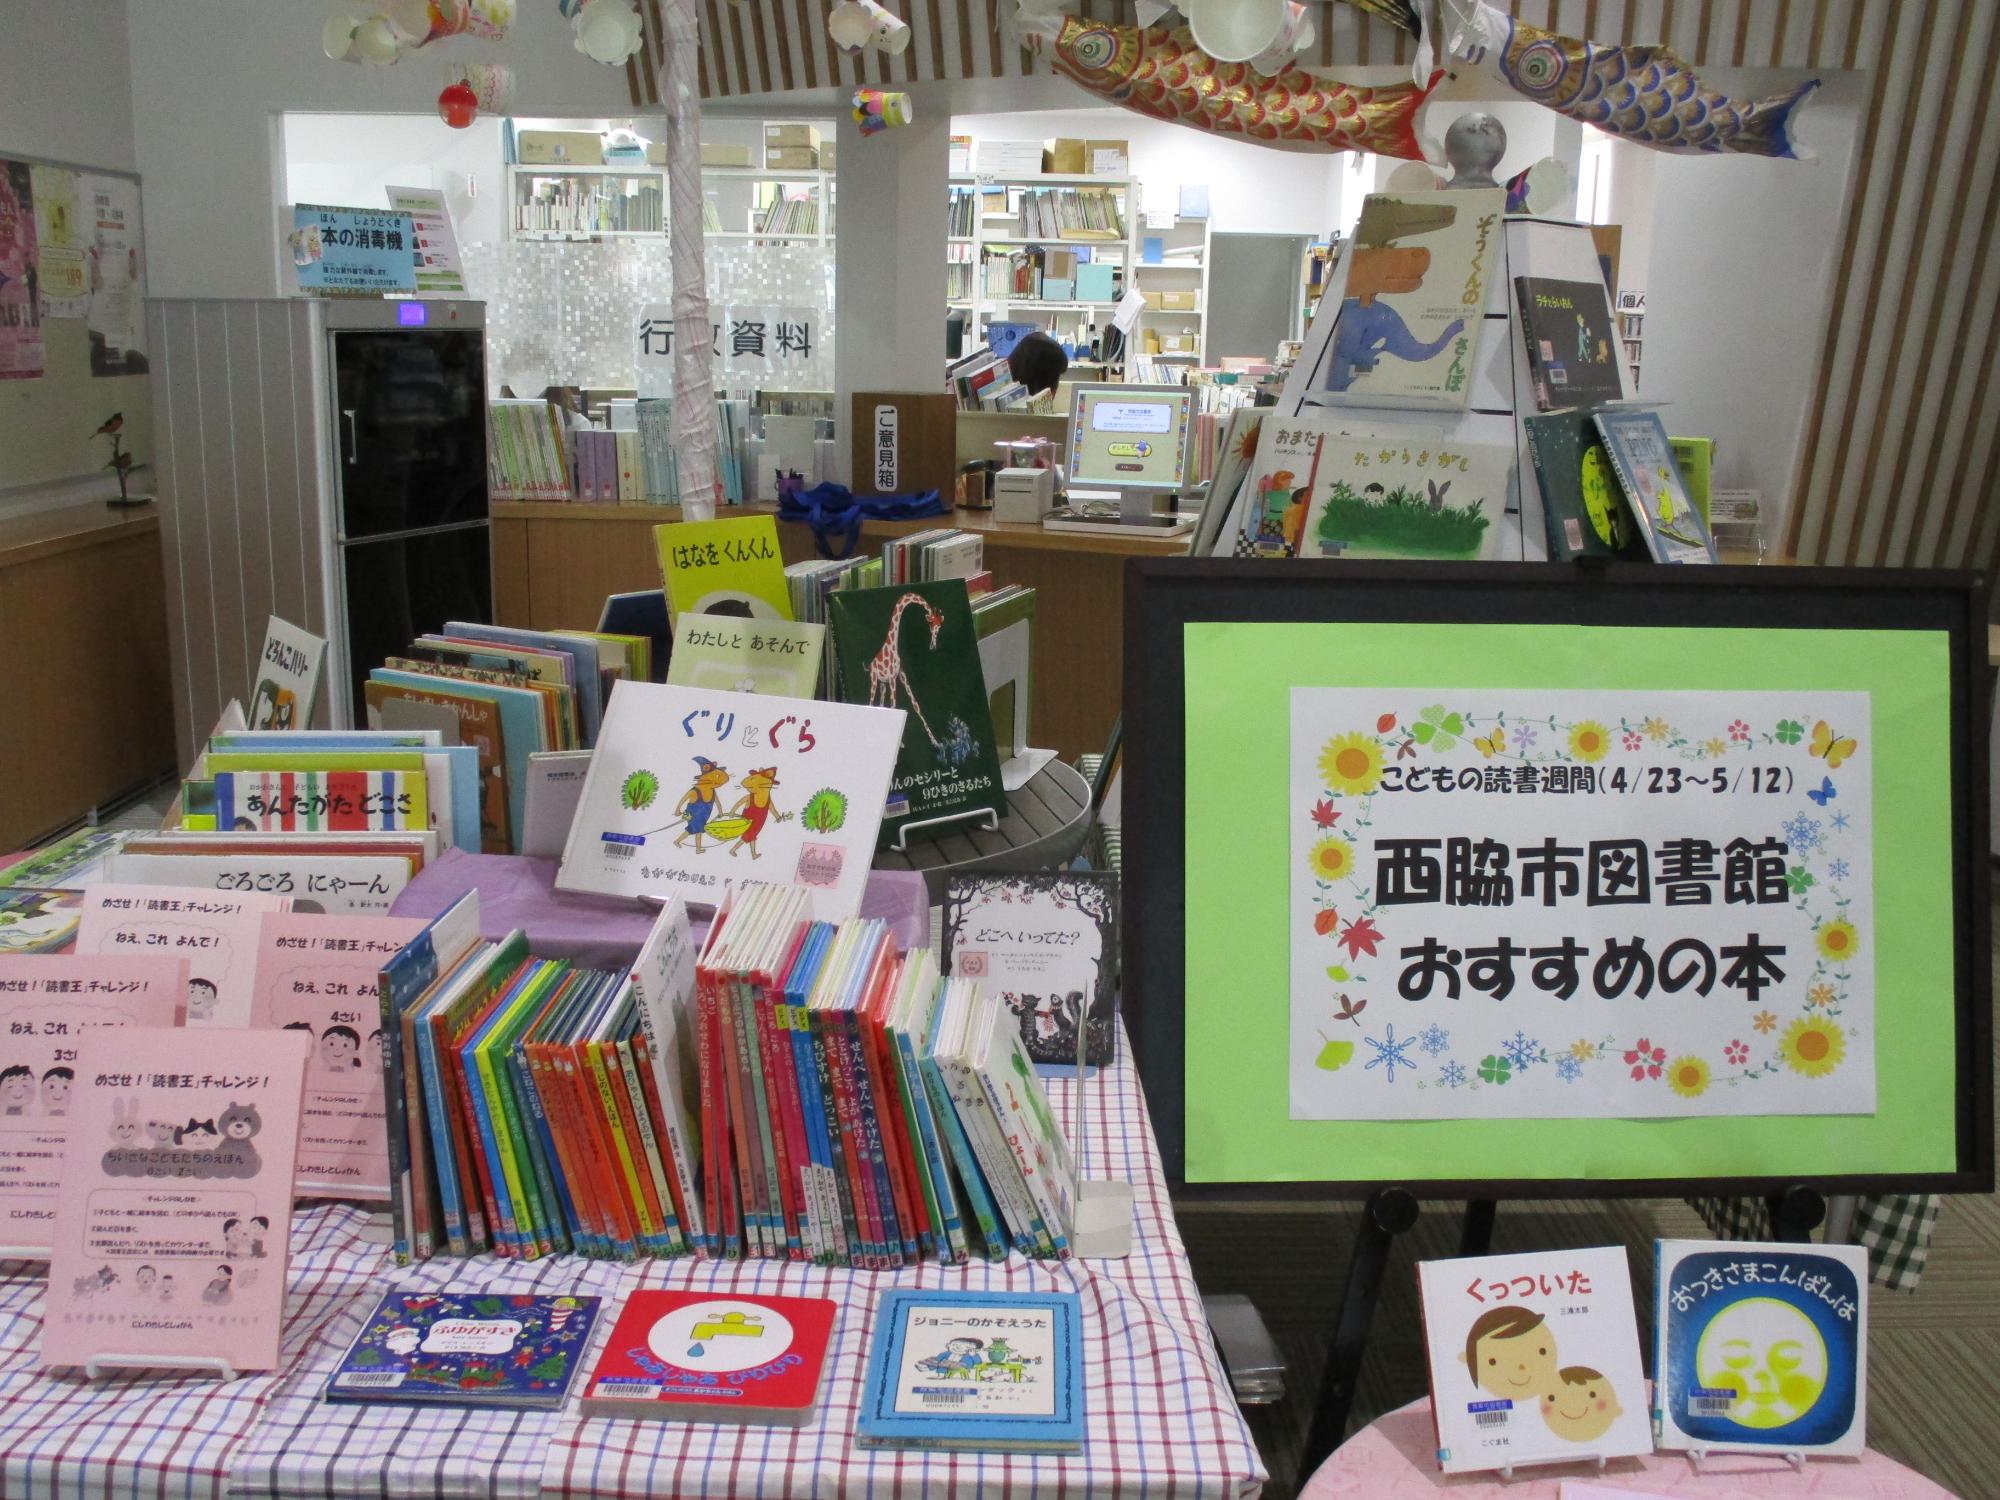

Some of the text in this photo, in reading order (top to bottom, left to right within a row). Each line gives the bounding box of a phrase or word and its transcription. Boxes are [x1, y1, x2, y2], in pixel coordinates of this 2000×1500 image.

[320, 213, 402, 228] ほん しょうどくき
[320, 226, 404, 251] 本の消毒機
[639, 318, 812, 359] 行資料
[878, 408, 896, 488] ご意見箱
[1275, 428, 1325, 448] おまた
[672, 536, 775, 569] はなを くんくん
[686, 629, 811, 656] わたしと あそんで
[264, 636, 309, 678] どろんこハリー
[682, 709, 817, 754] ぐりとぐら
[890, 766, 959, 791] んのセシリーと
[247, 791, 413, 817] あんたがた どこさ
[215, 870, 391, 895] ごろごろ にゃーん
[1373, 835, 1791, 908] 西脇市図書館
[101, 897, 242, 914] めざせ！「読書王」チャレンジ！
[115, 931, 220, 948] ねえ、これ よんで！
[975, 927, 1014, 944] どこへ
[1396, 932, 1787, 1002] おすすめの本
[292, 980, 349, 996] ねえ、これ
[329, 1010, 362, 1023] 4さい
[635, 984, 656, 1042] こんにちは
[10, 1020, 69, 1037] ねえ、これ
[826, 1035, 838, 1058] まて
[832, 1067, 843, 1089] まて
[94, 1073, 270, 1090] めざせ！「読書王」チャレンジ！
[813, 1039, 839, 1137] ちびすけ どっこい
[850, 1040, 867, 1073] せんべ
[864, 1118, 881, 1150] やけた
[107, 1152, 244, 1165] ちいさなこどもたちのえほん
[1465, 1269, 1593, 1303] くっついた
[1670, 1261, 1857, 1323] おつきさまこんばんは
[914, 1316, 1047, 1329] ジョニーのかぞえうた
[1559, 1304, 1589, 1316] 三浦太郎
[131, 1319, 194, 1330] にしわきしとしょかん
[626, 1346, 719, 1386] じゃあじゃあ
[1481, 1437, 1511, 1447] こぐま社
